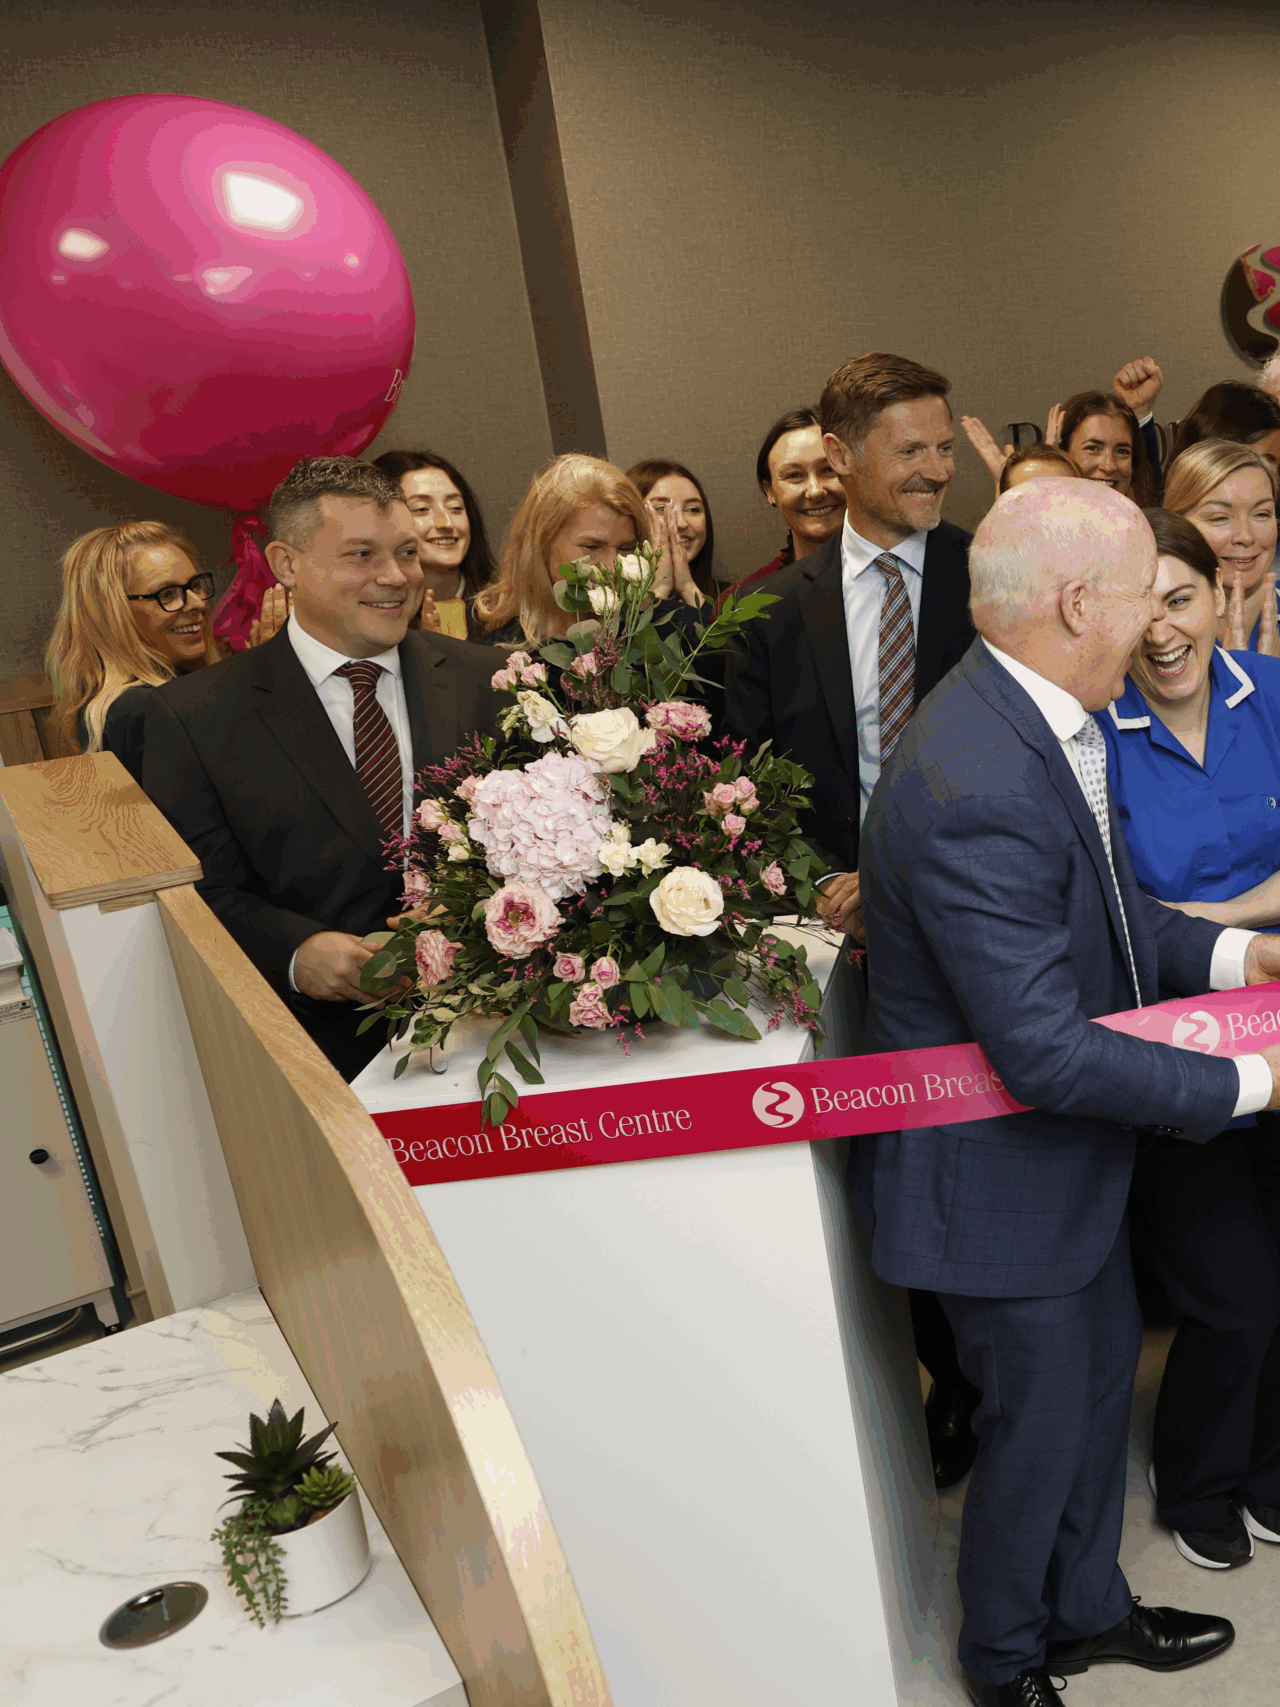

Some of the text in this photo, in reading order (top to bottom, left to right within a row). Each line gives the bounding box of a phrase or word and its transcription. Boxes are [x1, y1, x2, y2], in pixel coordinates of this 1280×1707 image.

[810, 1071, 1005, 1114] Beacon Breas
[385, 1108, 693, 1164] Beacon Breast Centre
